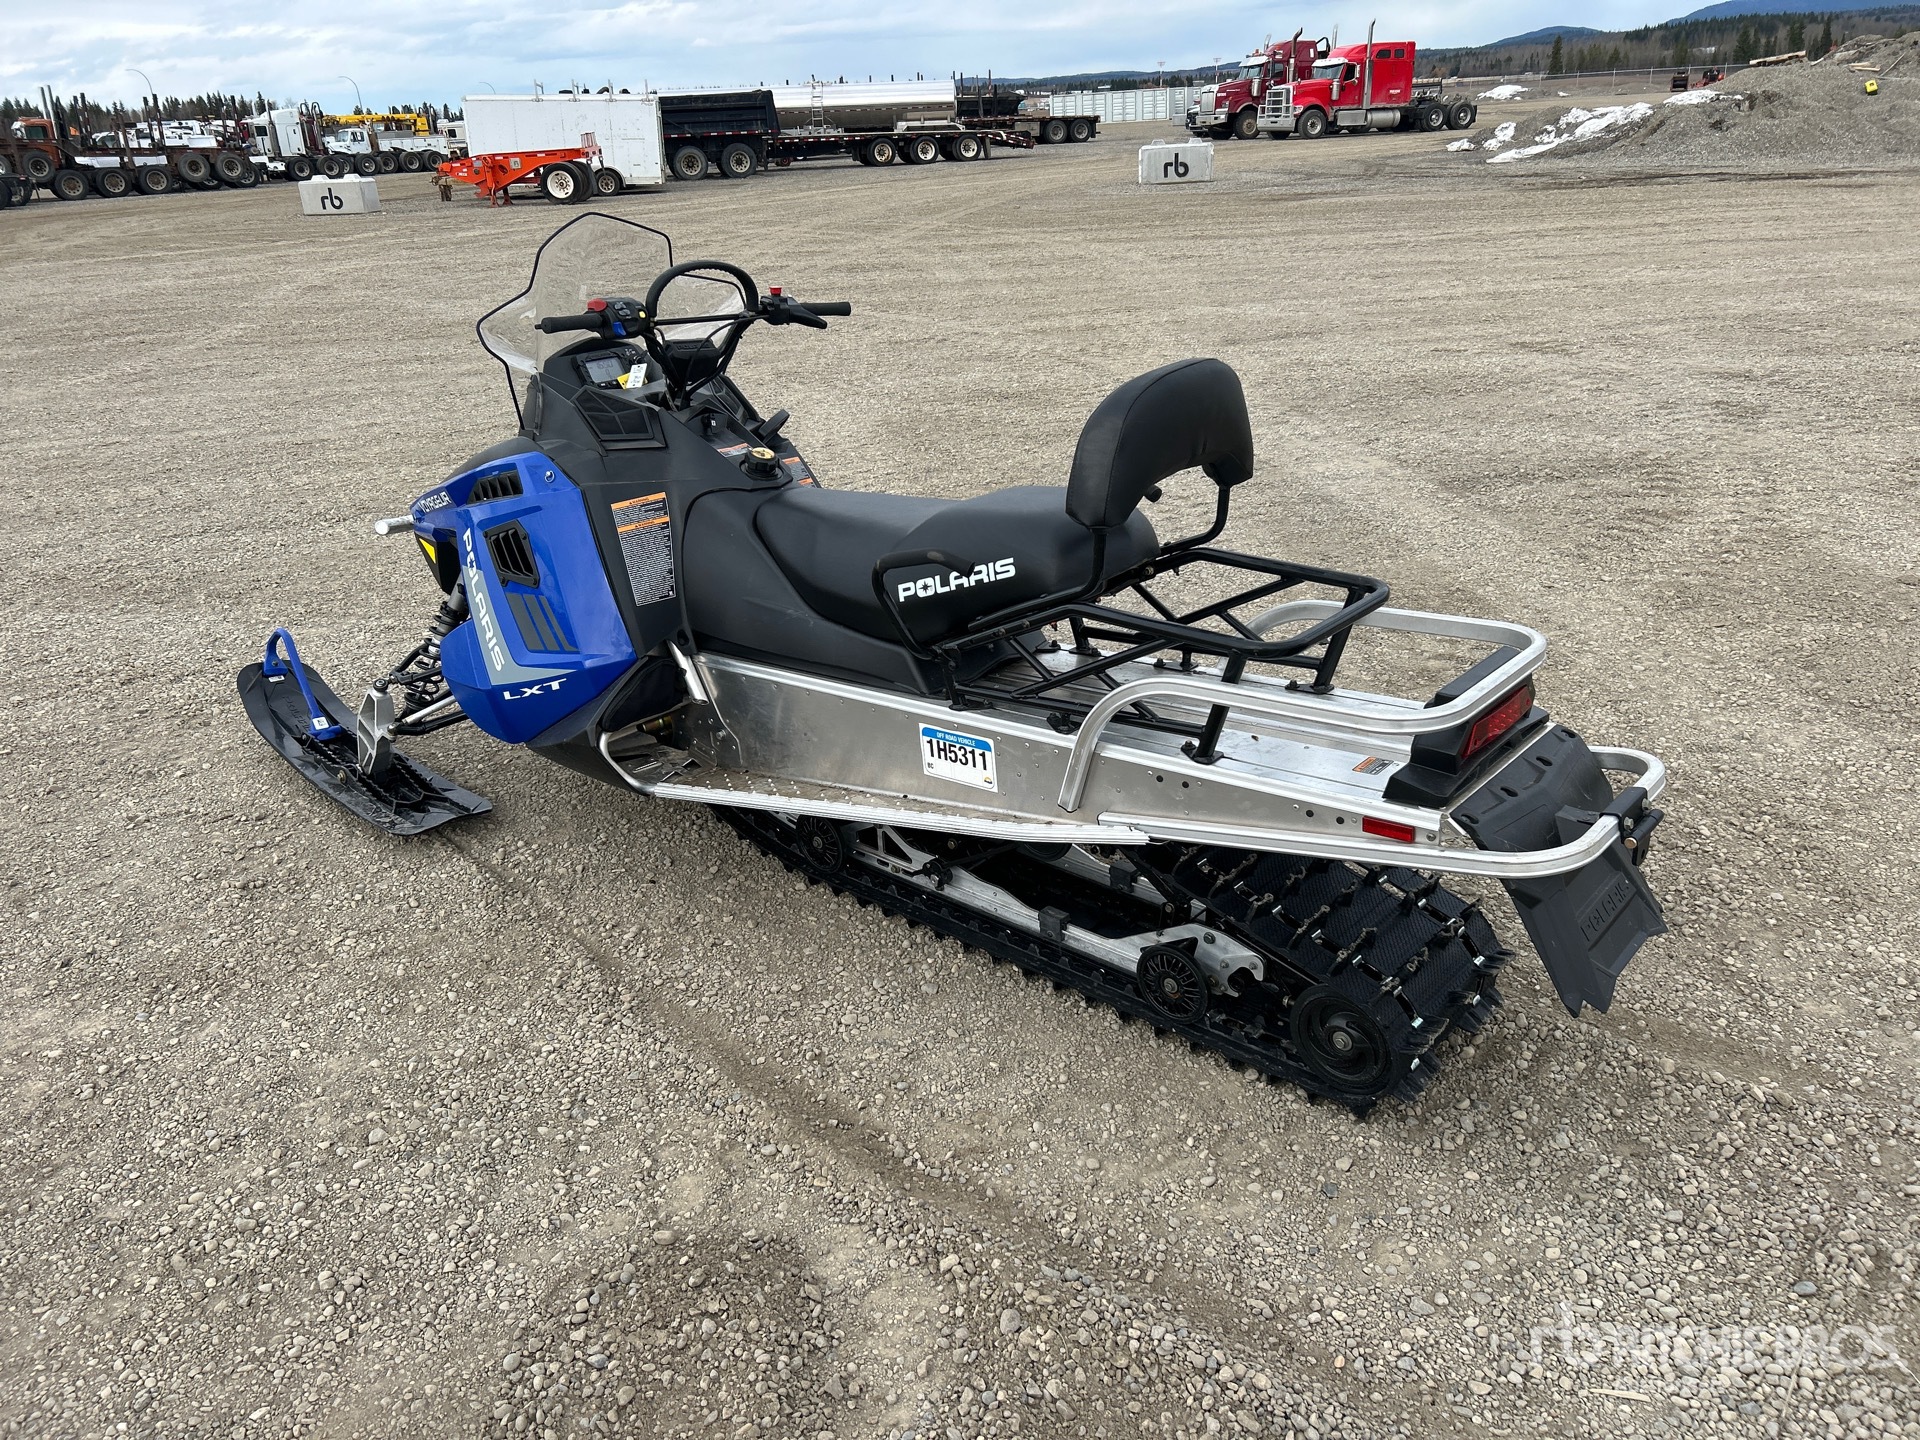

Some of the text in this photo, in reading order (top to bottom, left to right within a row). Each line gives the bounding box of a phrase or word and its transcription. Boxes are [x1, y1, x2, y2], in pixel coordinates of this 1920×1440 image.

[1164, 153, 1189, 178] rb
[321, 187, 343, 210] rb
[898, 557, 1016, 602] POLARIS
[463, 527, 505, 671] POLARIS
[503, 678, 567, 700] LXT
[945, 734, 957, 742] ROAD
[957, 737, 976, 747] VEHICLE
[926, 738, 987, 771] 1H5311
